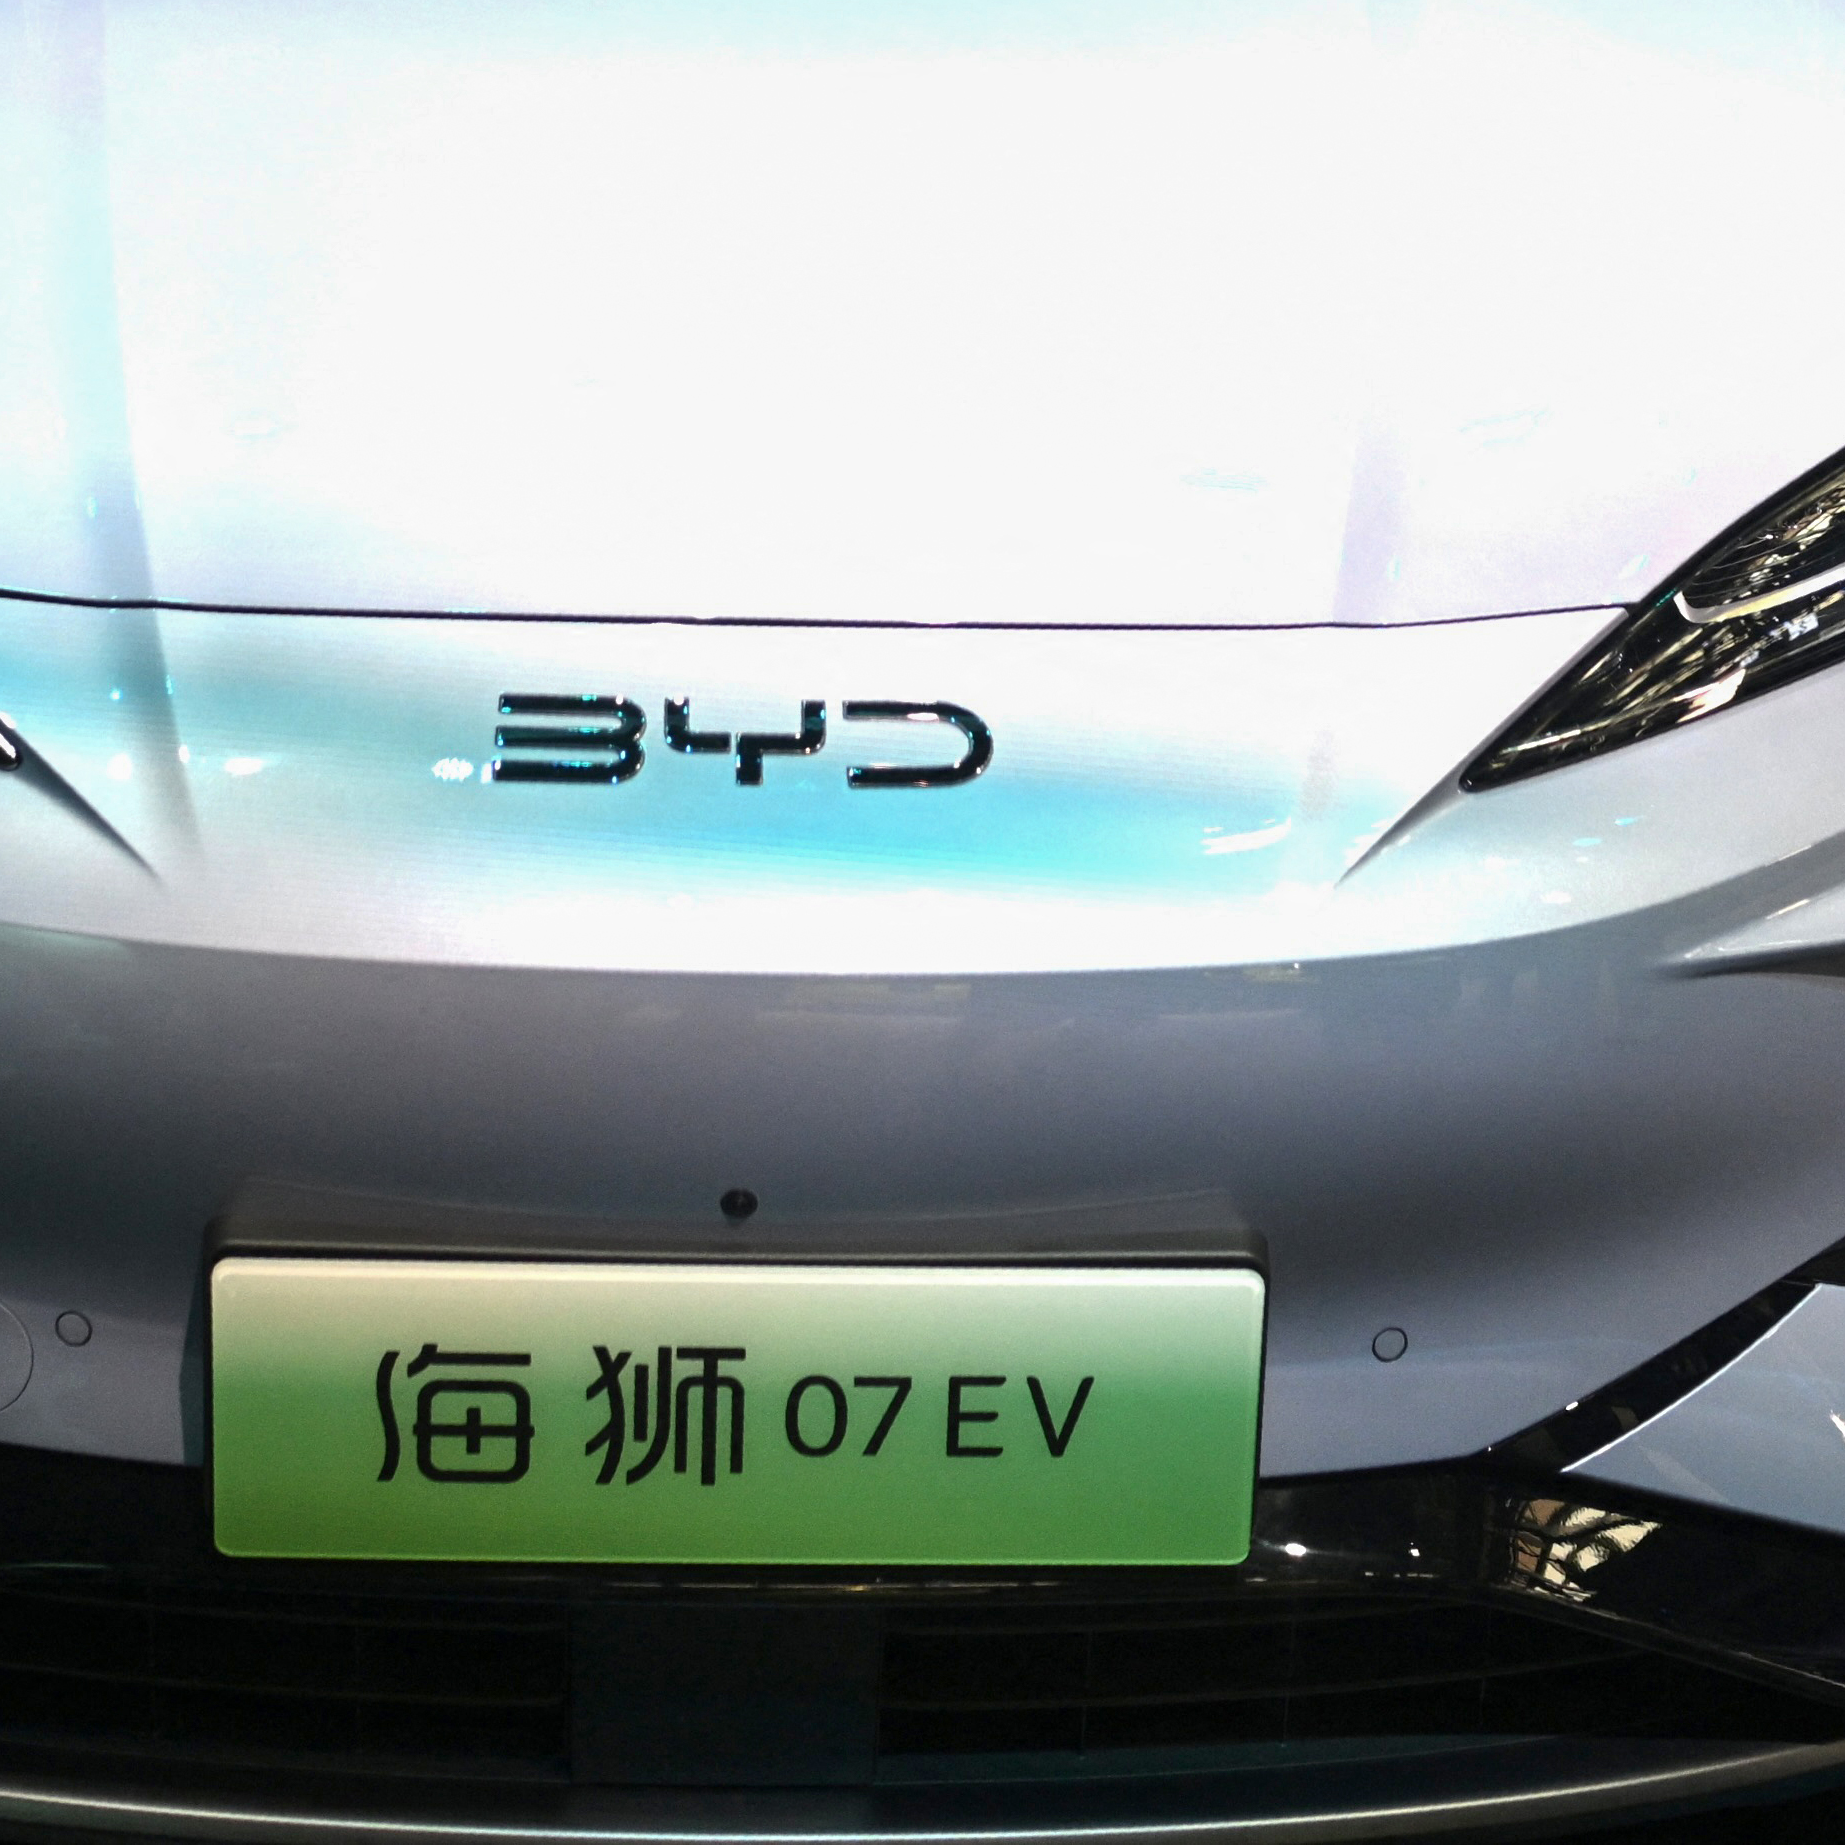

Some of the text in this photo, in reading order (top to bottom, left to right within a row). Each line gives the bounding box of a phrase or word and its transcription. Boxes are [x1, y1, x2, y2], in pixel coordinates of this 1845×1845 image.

[492, 692, 994, 788] BYD
[376, 1344, 1095, 1486] 海狮 07 EV
